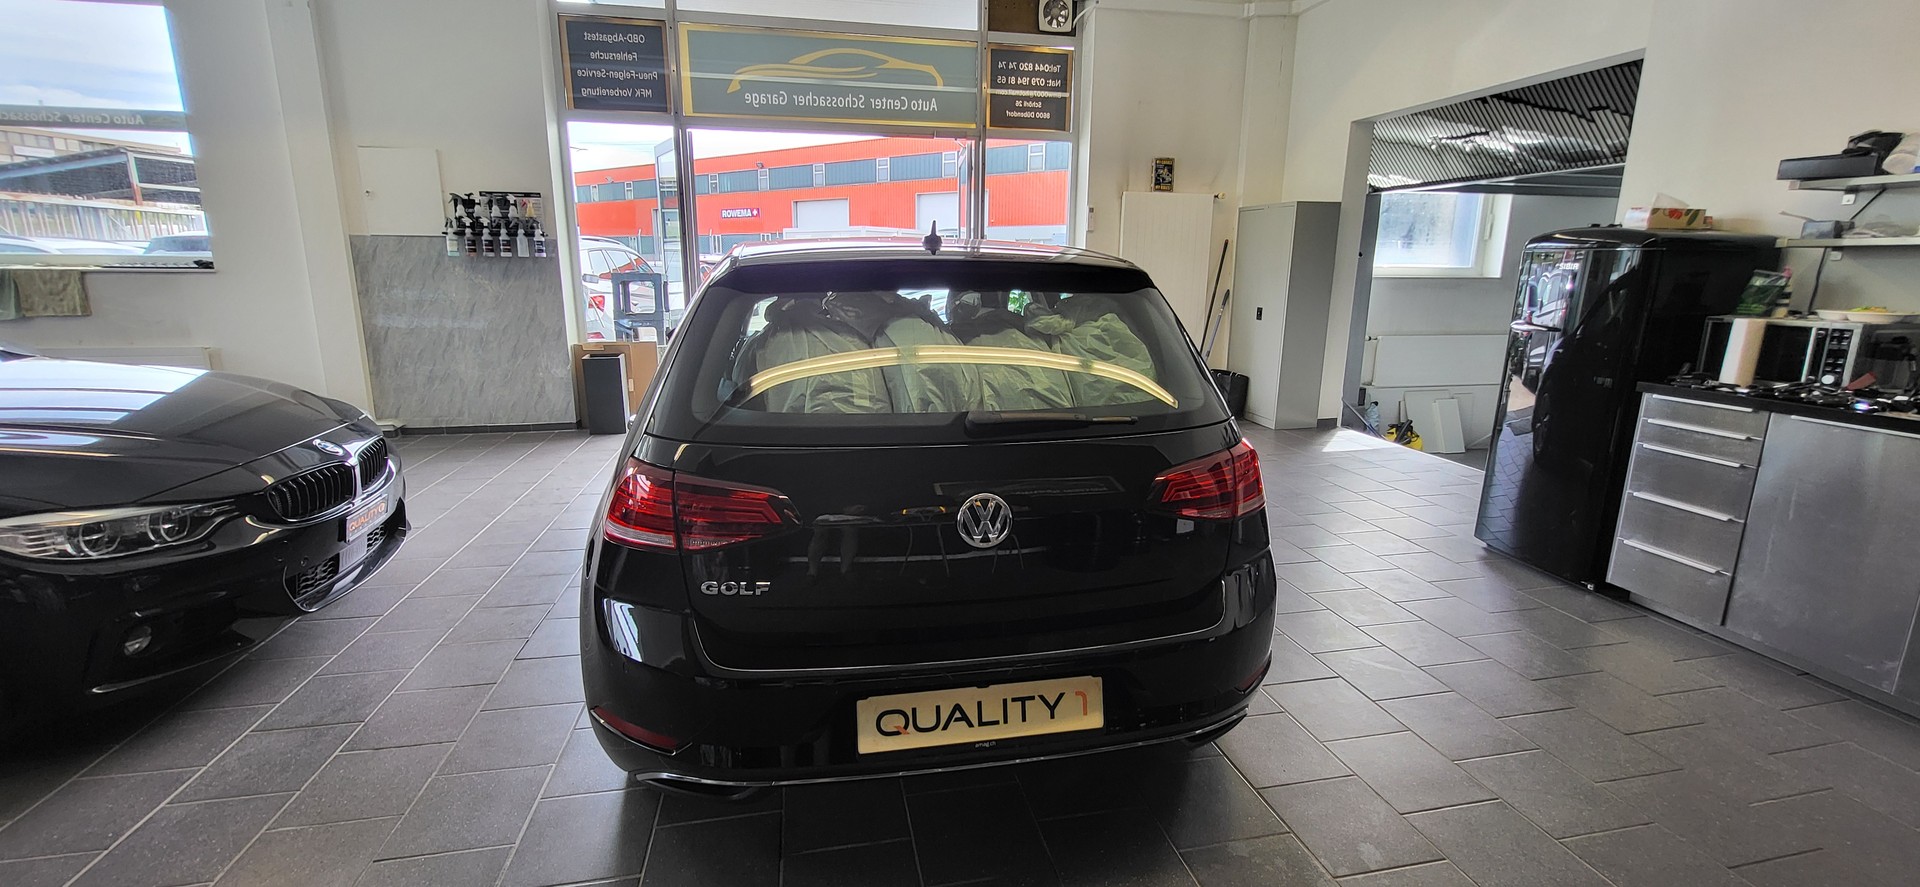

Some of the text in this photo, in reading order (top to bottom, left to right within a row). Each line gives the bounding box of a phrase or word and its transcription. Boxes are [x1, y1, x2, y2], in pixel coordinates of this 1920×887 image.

[722, 208, 752, 218] ROWEMA
[701, 581, 770, 595] GOLF
[875, 691, 1088, 737] QUALITY 1
